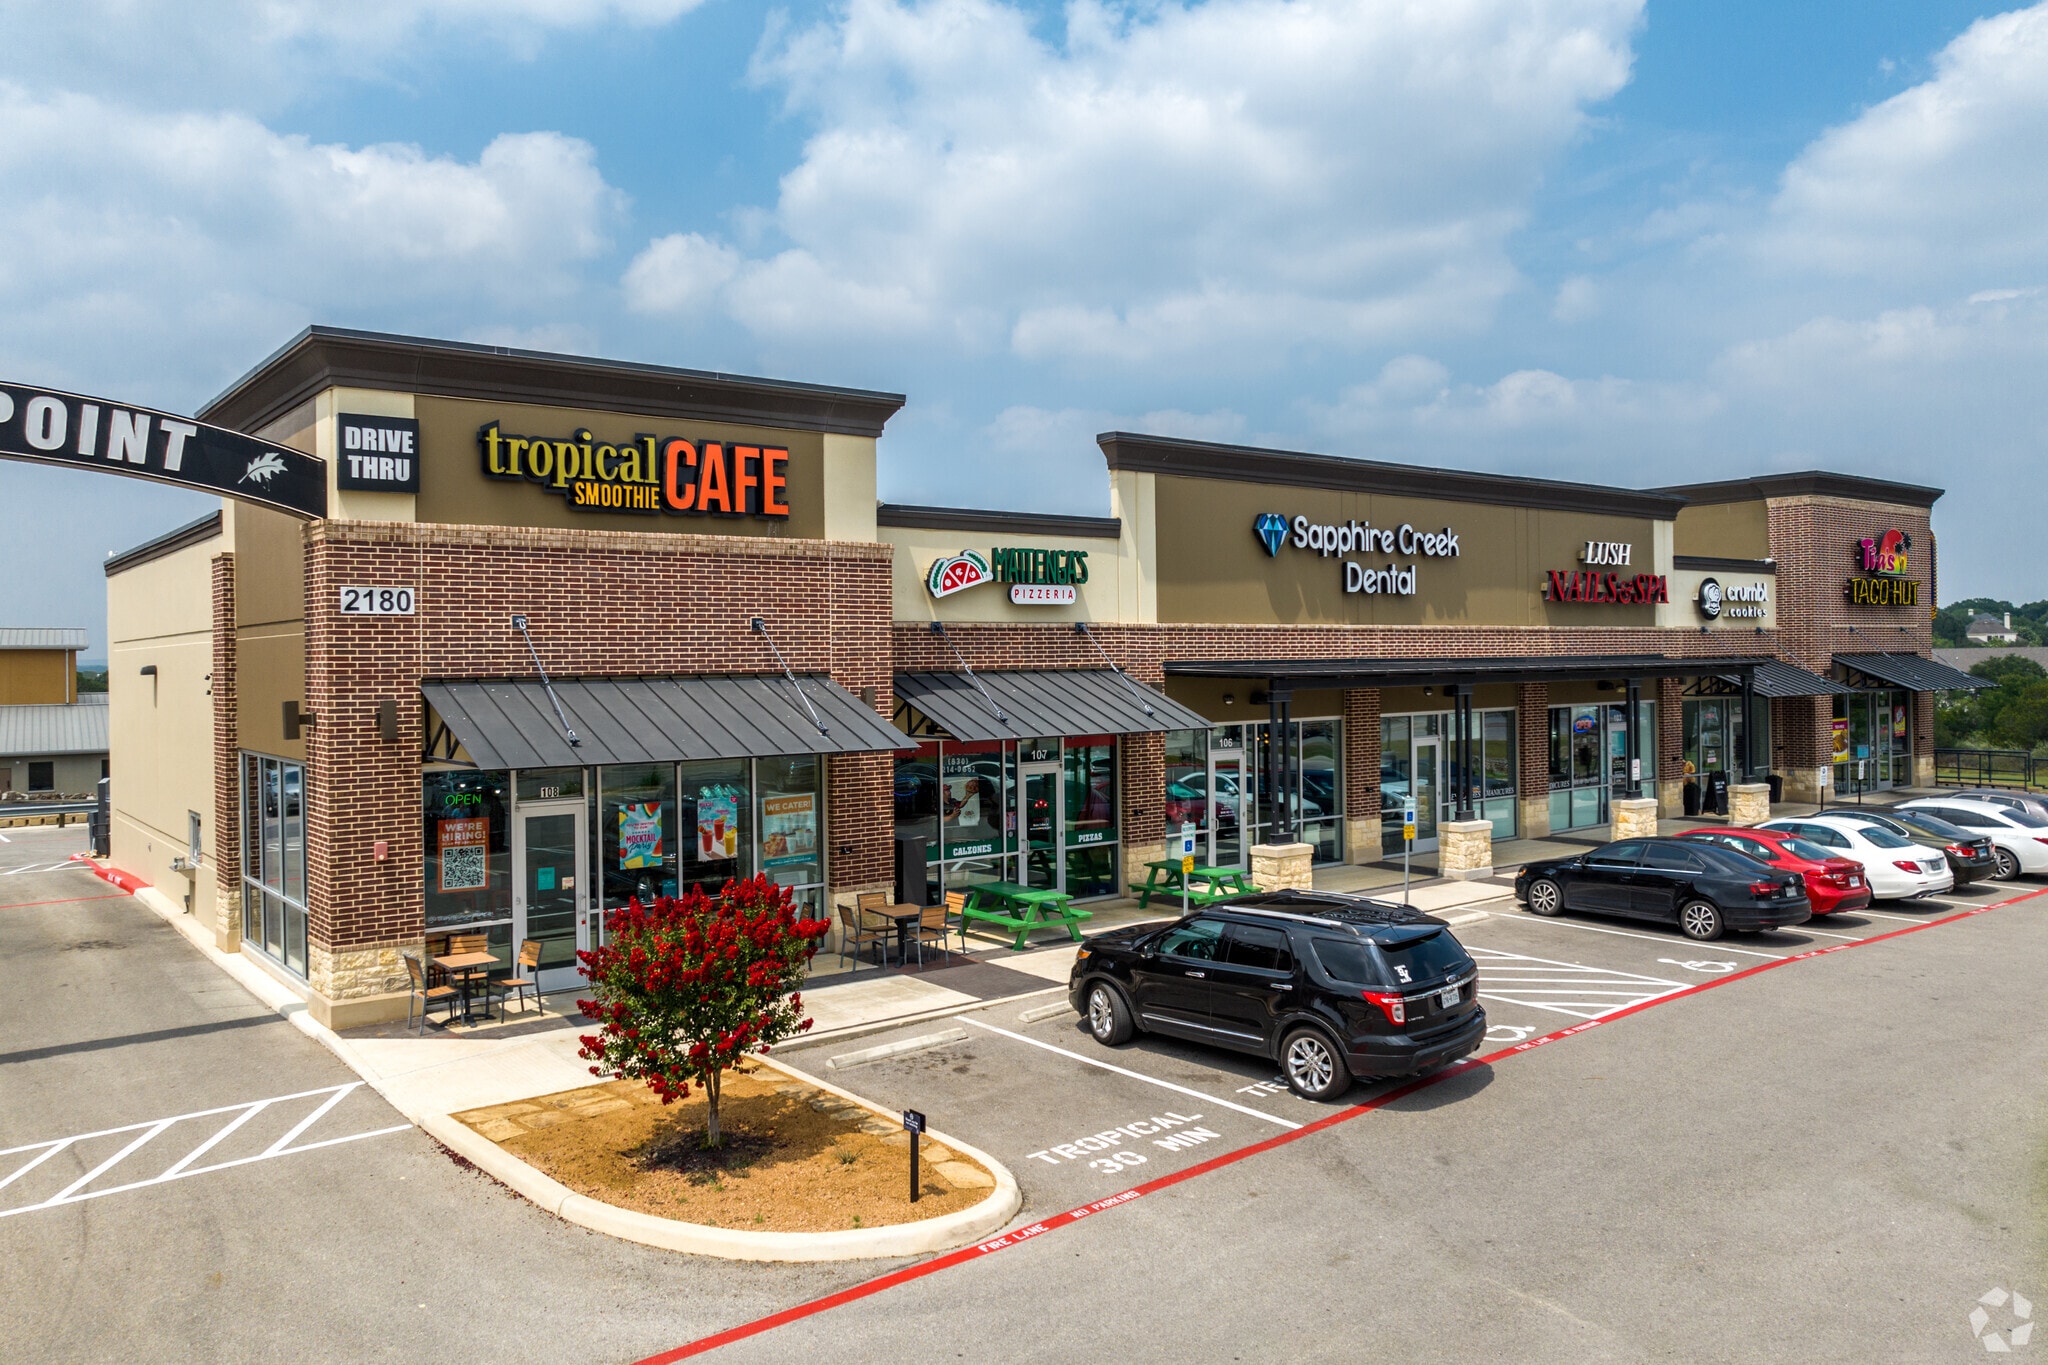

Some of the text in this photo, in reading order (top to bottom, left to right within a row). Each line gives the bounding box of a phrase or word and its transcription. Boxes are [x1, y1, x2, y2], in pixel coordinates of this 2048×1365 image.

[344, 426, 414, 454] DRIVE
[483, 426, 660, 488] tropical
[347, 455, 411, 482] THRU
[665, 440, 790, 515] CAFE
[574, 482, 660, 510] SMOOTHIE
[1292, 515, 1460, 558] Sapphire Creek
[1584, 540, 1632, 566] LUSH
[992, 547, 1089, 585] MATTENGA'S
[1344, 562, 1416, 596] Dental
[343, 588, 412, 612] 2180
[1014, 588, 1074, 600] PIZZERIA
[1727, 582, 1769, 602] crumbl
[1851, 578, 1921, 606] TACO HUT
[1730, 605, 1768, 617] cookies
[1219, 738, 1233, 748] 106
[947, 757, 969, 766] (830)
[1031, 749, 1048, 760] 107
[445, 793, 482, 806] OPEN
[542, 787, 558, 798] 108
[766, 800, 812, 812] WE CATER!
[441, 831, 486, 841] HIRING!
[445, 822, 483, 832] WE'RE
[1078, 832, 1103, 843] PIZZAS
[626, 833, 657, 844] MOCKTAIL
[952, 844, 993, 857] CALZONES
[1026, 1111, 1204, 1165] TROPICAL
[1088, 1126, 1222, 1174] 30 MIN
[978, 1190, 1141, 1253] FIRE LANE NO PARKING
